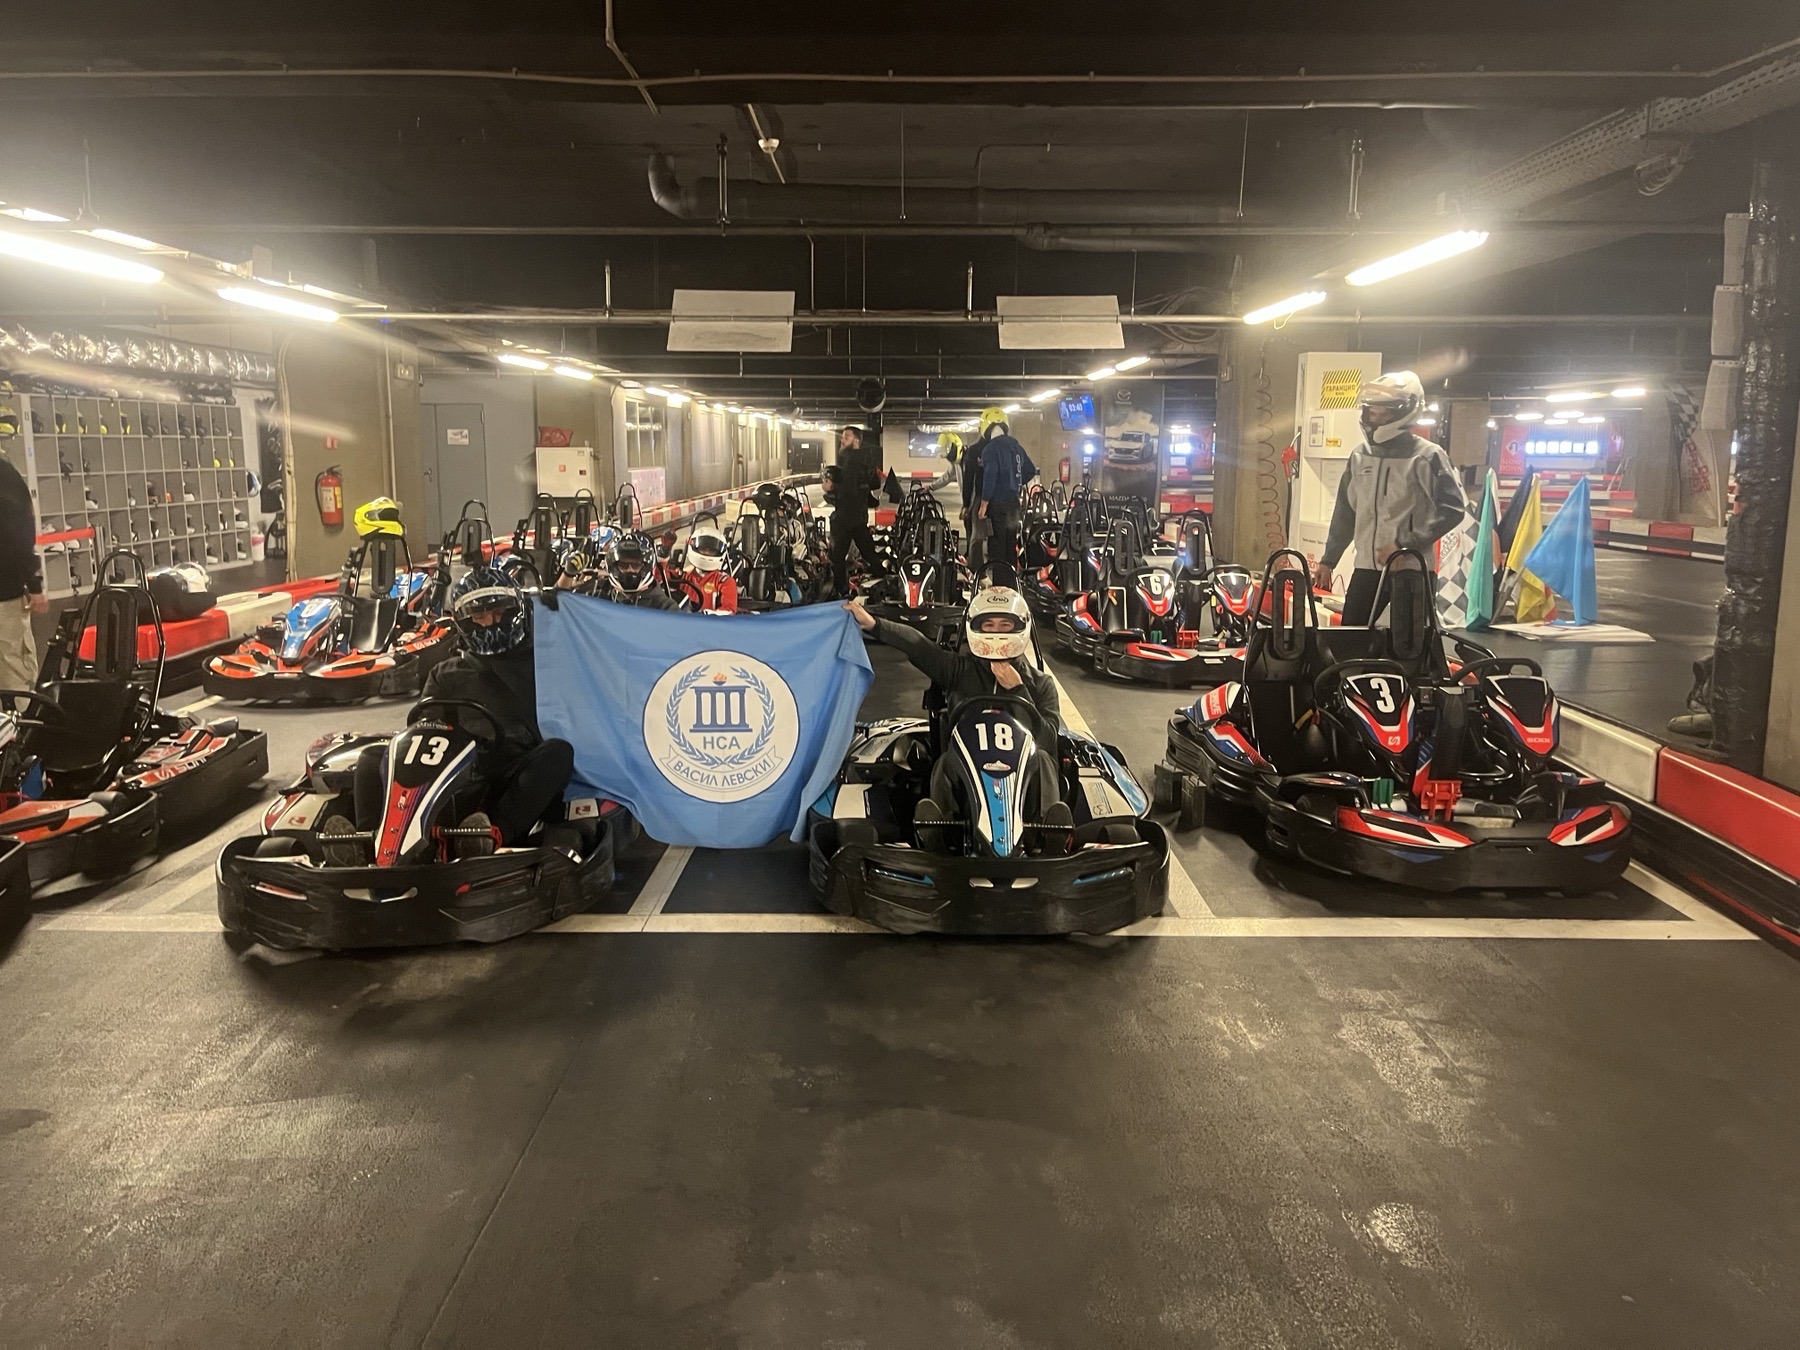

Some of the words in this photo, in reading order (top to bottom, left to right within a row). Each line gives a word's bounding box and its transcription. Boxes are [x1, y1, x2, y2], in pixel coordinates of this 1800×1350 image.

[1325, 384, 1356, 392] ГАРАНЦИЯ
[1050, 532, 1057, 545] 4
[911, 563, 921, 576] 3
[1149, 575, 1163, 595] 6
[1369, 677, 1395, 713] 3
[703, 736, 741, 750] НСА
[975, 722, 1014, 751] 18
[403, 734, 449, 766] 13
[673, 760, 719, 787] ВАСИЛ
[721, 758, 771, 787] ЛЕВСКИ
